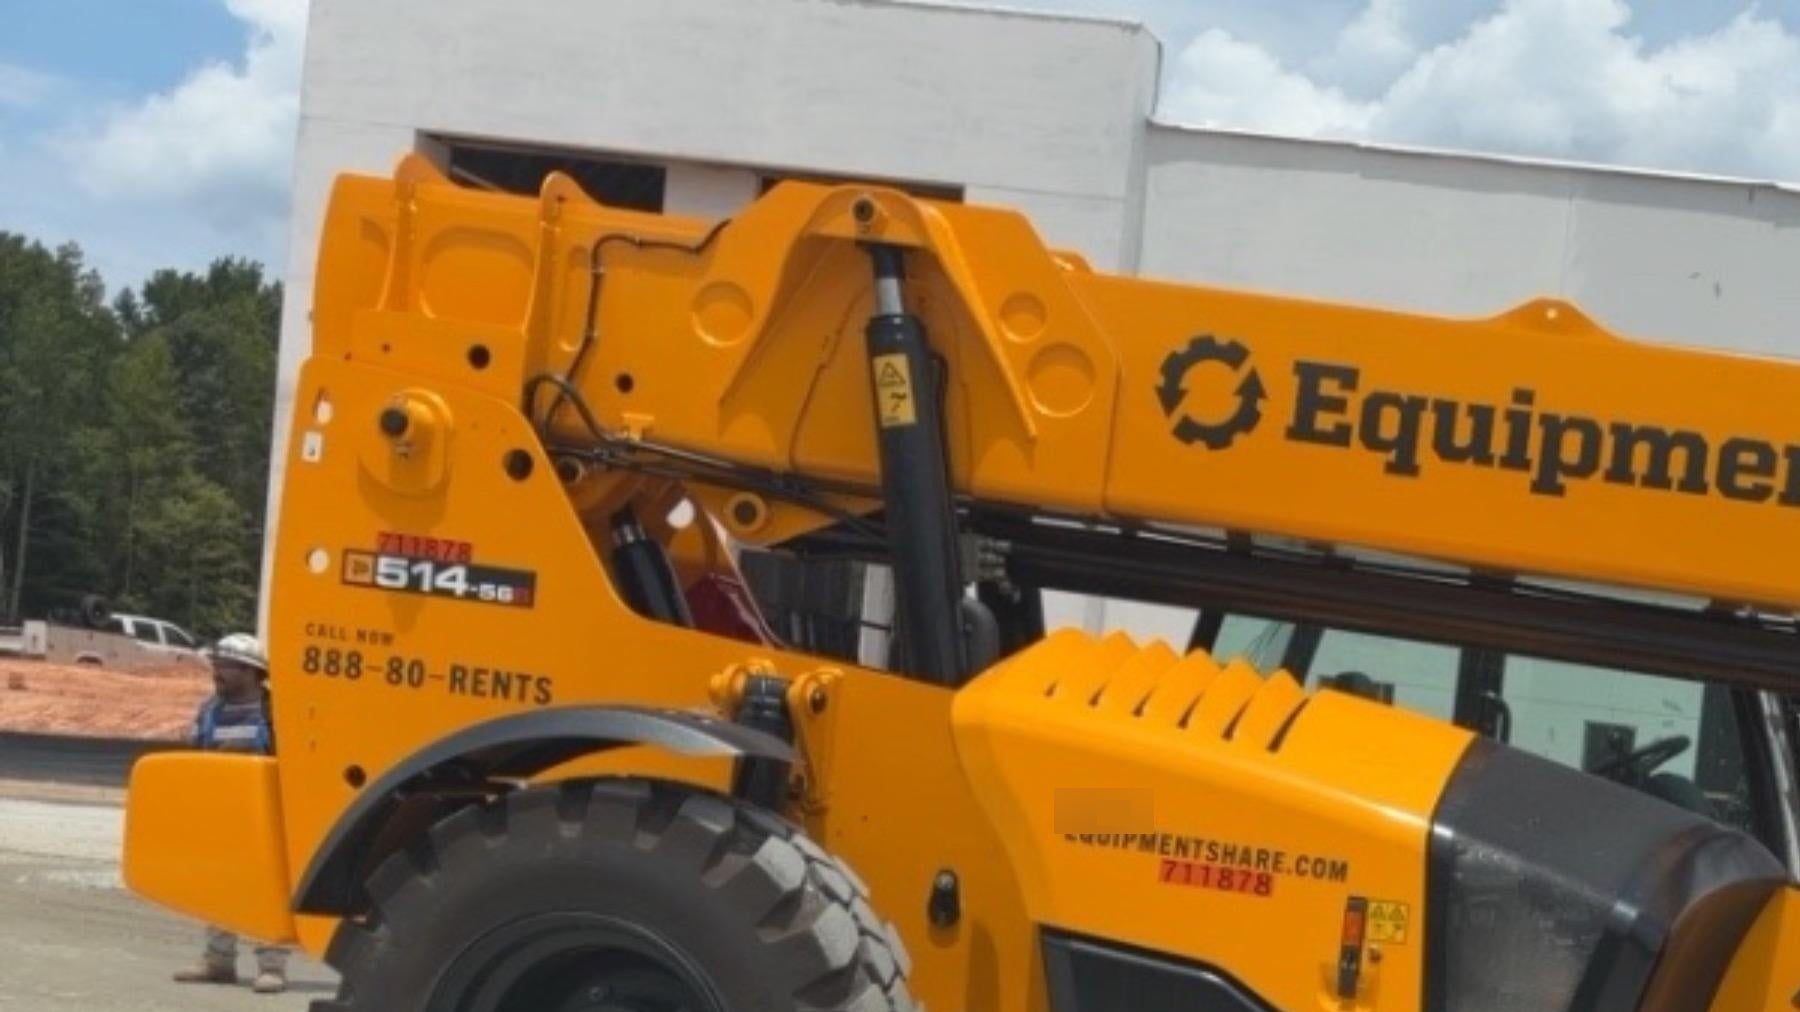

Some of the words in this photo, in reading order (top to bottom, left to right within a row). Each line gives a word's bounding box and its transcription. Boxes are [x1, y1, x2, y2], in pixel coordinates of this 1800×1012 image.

[304, 622, 347, 642] CALL
[356, 628, 395, 647] NOW
[302, 646, 554, 705] 888-80-RENTS
[1160, 859, 1274, 897] 711878
